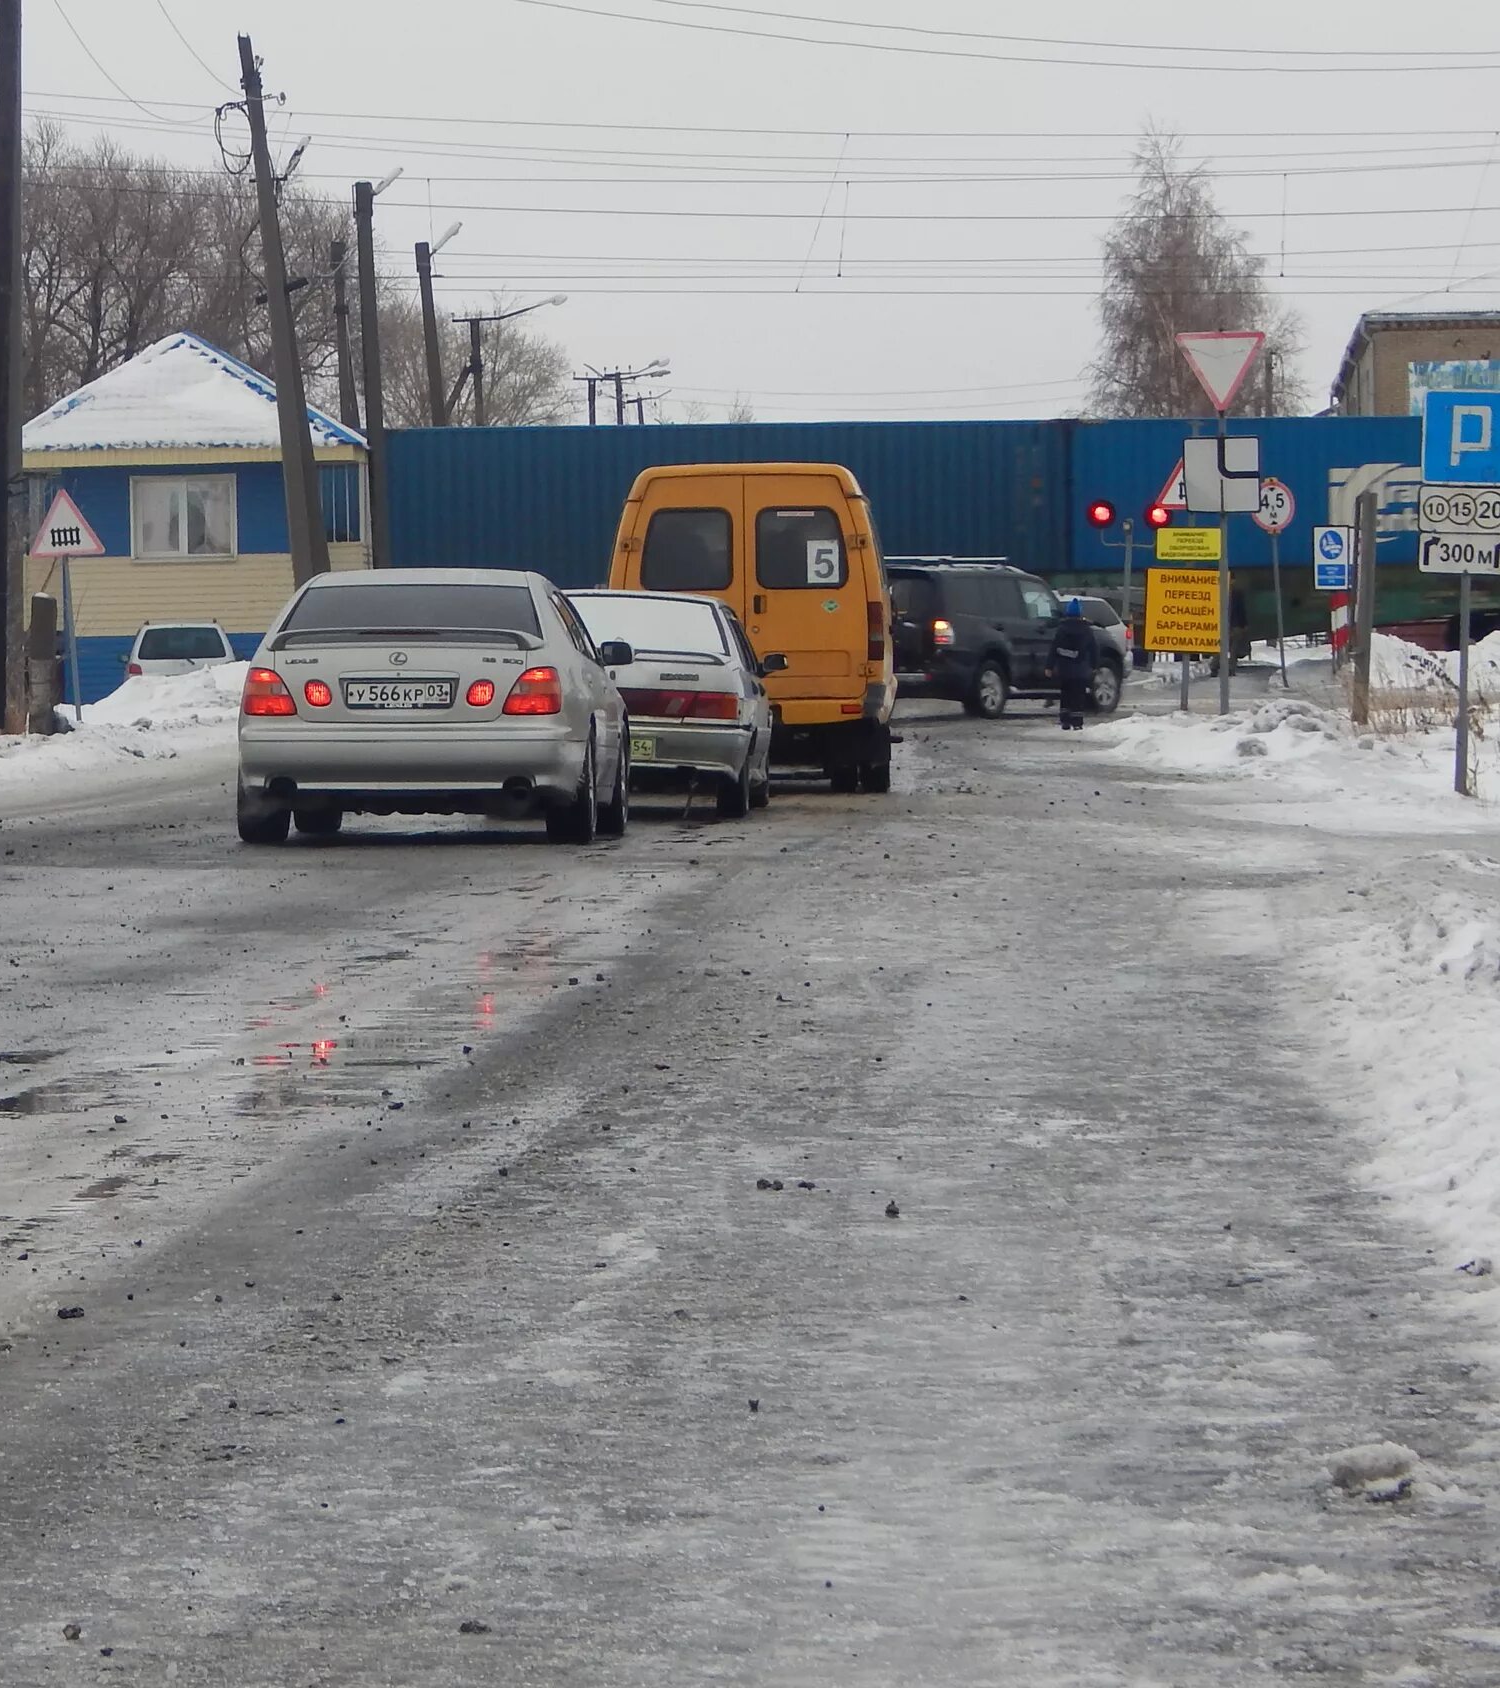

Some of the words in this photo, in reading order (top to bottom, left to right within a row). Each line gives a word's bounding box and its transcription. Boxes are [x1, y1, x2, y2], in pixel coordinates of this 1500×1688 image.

[1450, 405, 1492, 466] P
[1427, 502, 1445, 516] 10
[1452, 502, 1471, 517] 15
[1439, 543, 1474, 563] 300
[814, 548, 834, 579] 5
[1164, 590, 1212, 602] ПЕРЕЕЗД
[1156, 620, 1218, 631] БАРЬЕРАМИ
